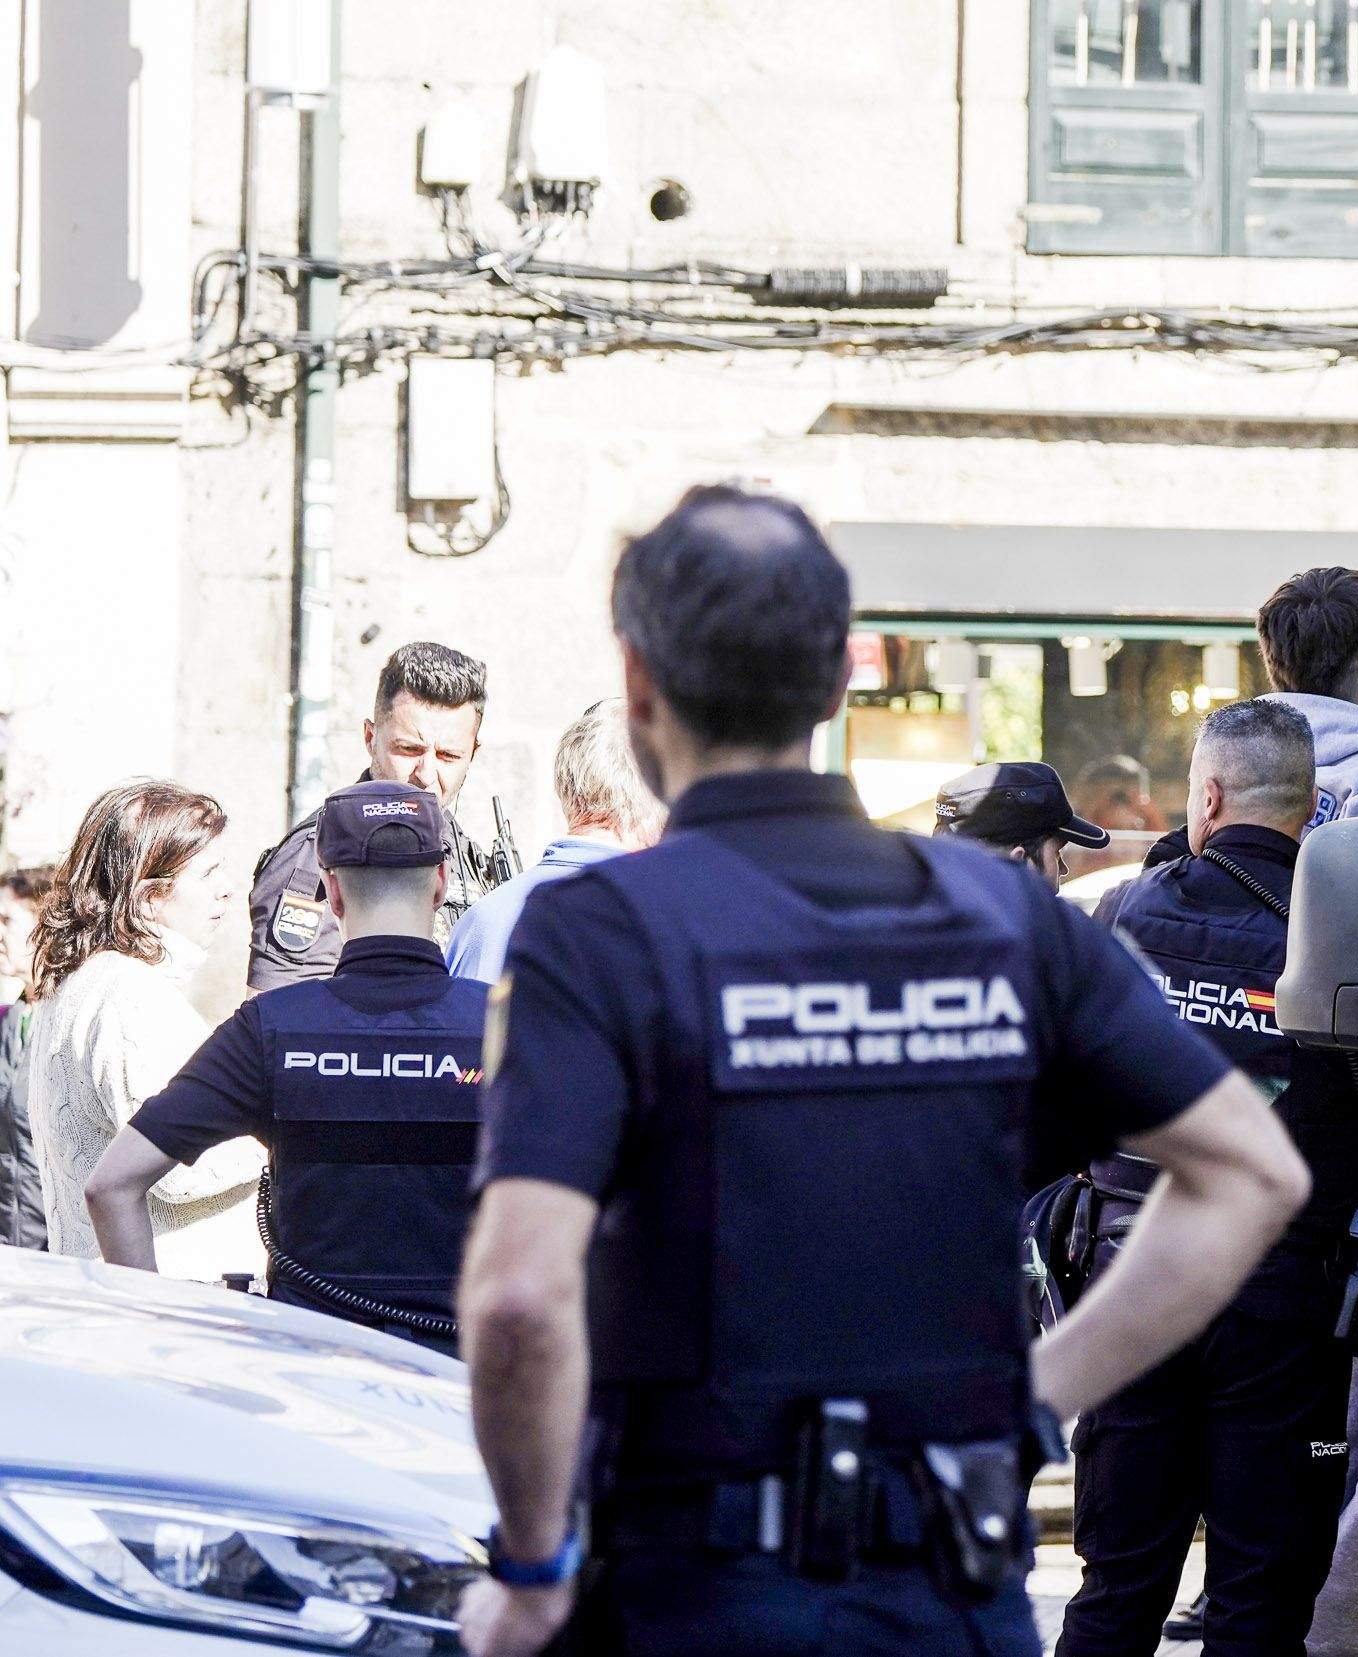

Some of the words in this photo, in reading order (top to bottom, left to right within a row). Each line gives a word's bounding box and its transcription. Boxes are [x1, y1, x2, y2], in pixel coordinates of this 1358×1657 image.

[362, 802, 406, 811] POLICIA
[363, 808, 418, 817] NACIONAL
[722, 976, 1025, 1035] POLICIA
[1150, 973, 1250, 1008] OLICIA
[1167, 998, 1285, 1036] IONAL
[284, 1051, 463, 1078] POLICIA
